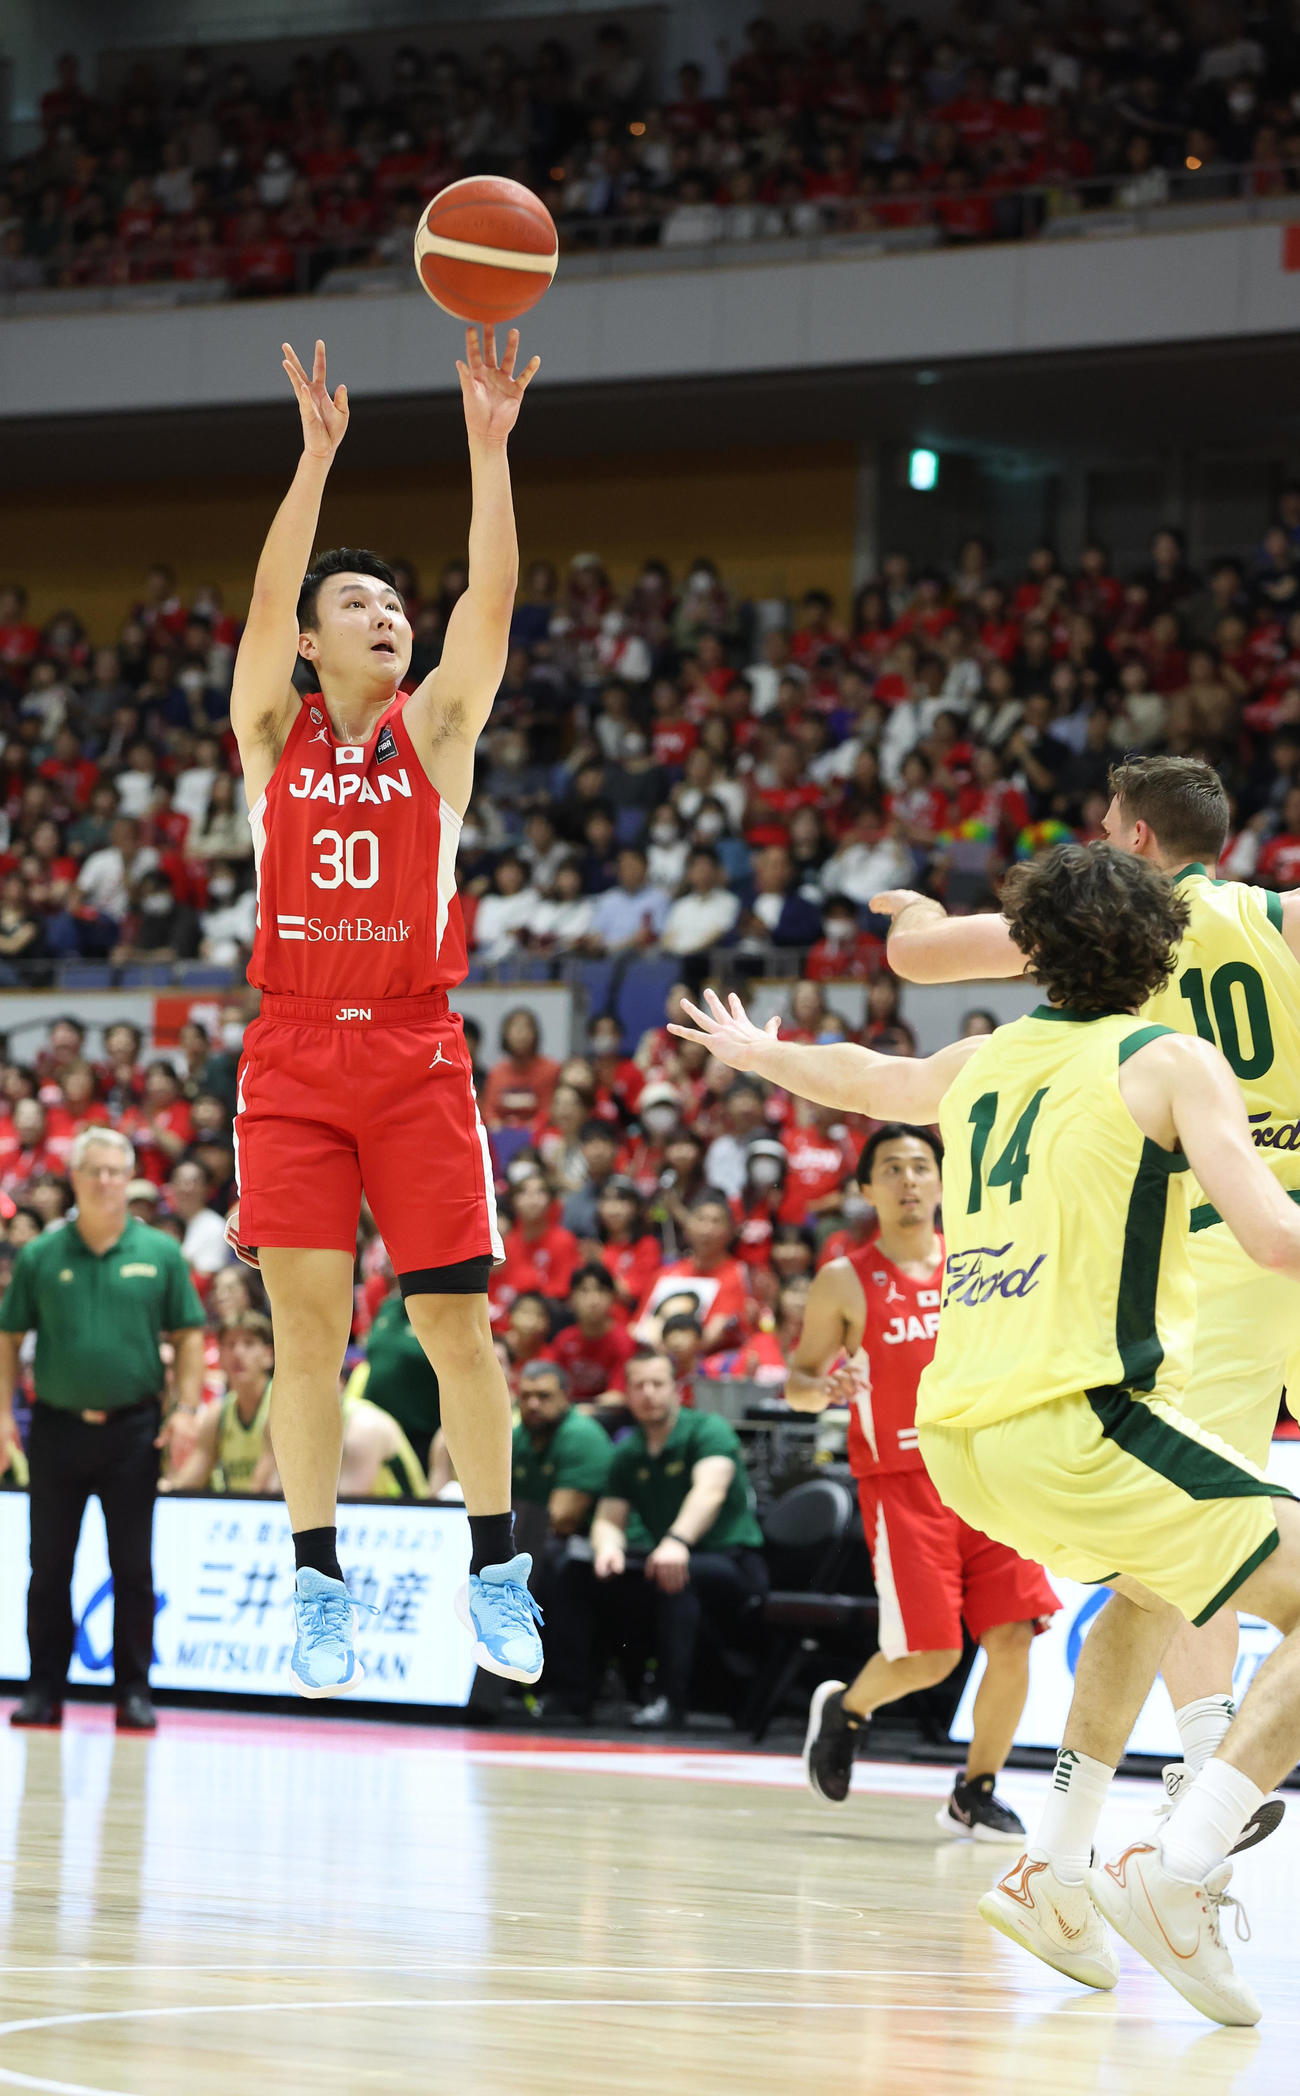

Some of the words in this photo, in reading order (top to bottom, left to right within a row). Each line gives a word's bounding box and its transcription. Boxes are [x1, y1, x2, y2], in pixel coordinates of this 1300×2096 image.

[378, 740, 392, 753] FIBA
[289, 767, 413, 806] JAPAN
[311, 828, 380, 890] 30
[307, 917, 411, 942] SoftBank
[335, 1008, 372, 1021] JPN
[1179, 961, 1275, 1081] 10
[966, 1086, 1051, 1215] 14
[943, 1241, 1048, 1308] Ford
[186, 1558, 430, 1635] 三井動産
[176, 1639, 267, 1673] MITSUI
